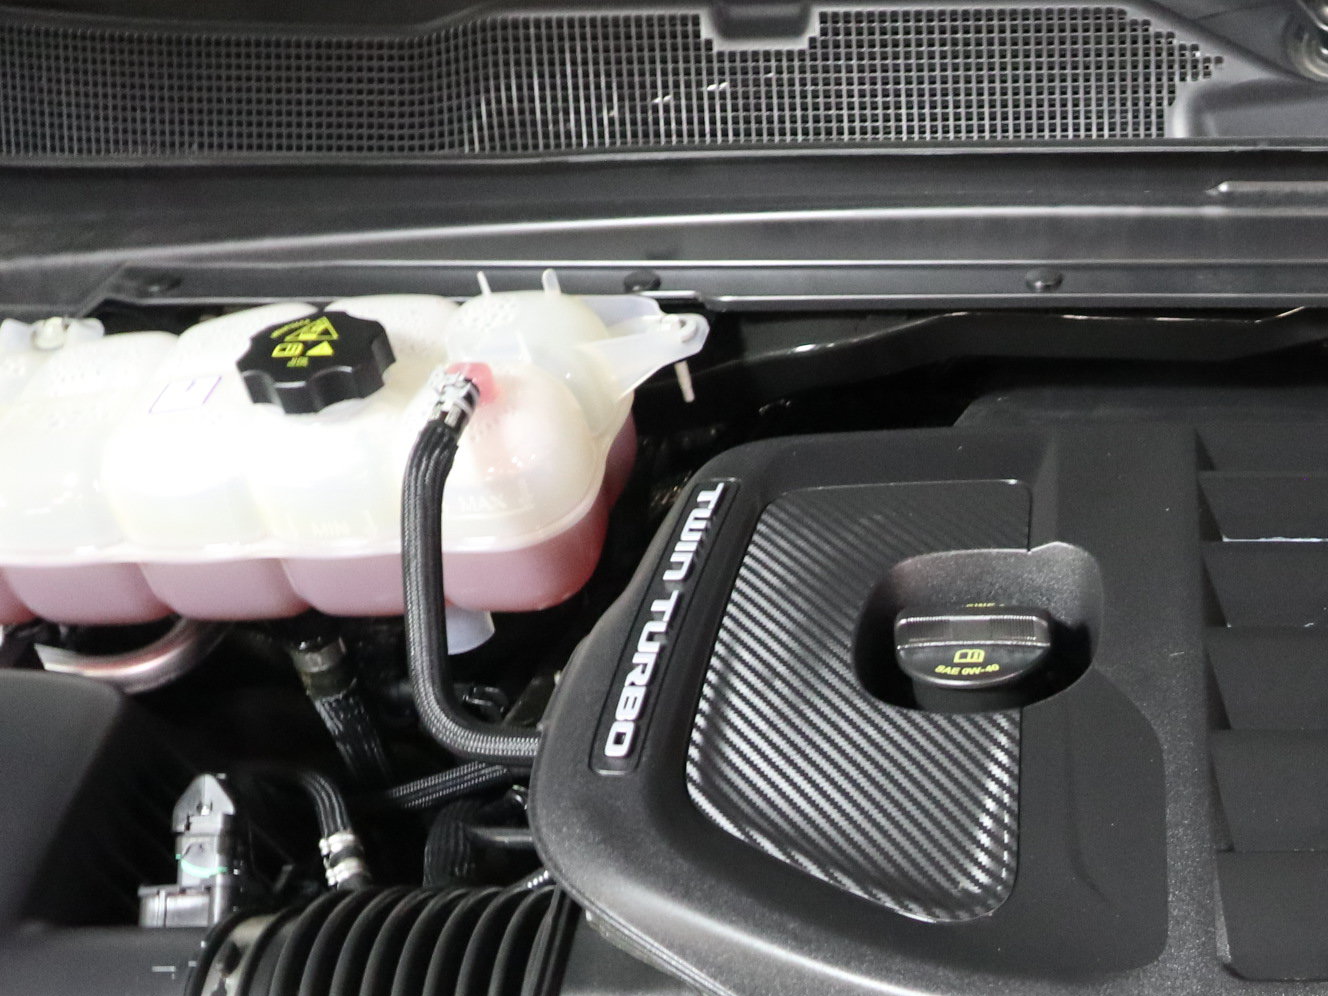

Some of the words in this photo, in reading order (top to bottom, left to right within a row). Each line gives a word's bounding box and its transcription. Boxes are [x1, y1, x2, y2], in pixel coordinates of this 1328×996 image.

[662, 482, 725, 581] TWIN
[604, 589, 680, 757] TURBO
[935, 665, 960, 675] SAE
[961, 664, 1000, 675] 0W-40
